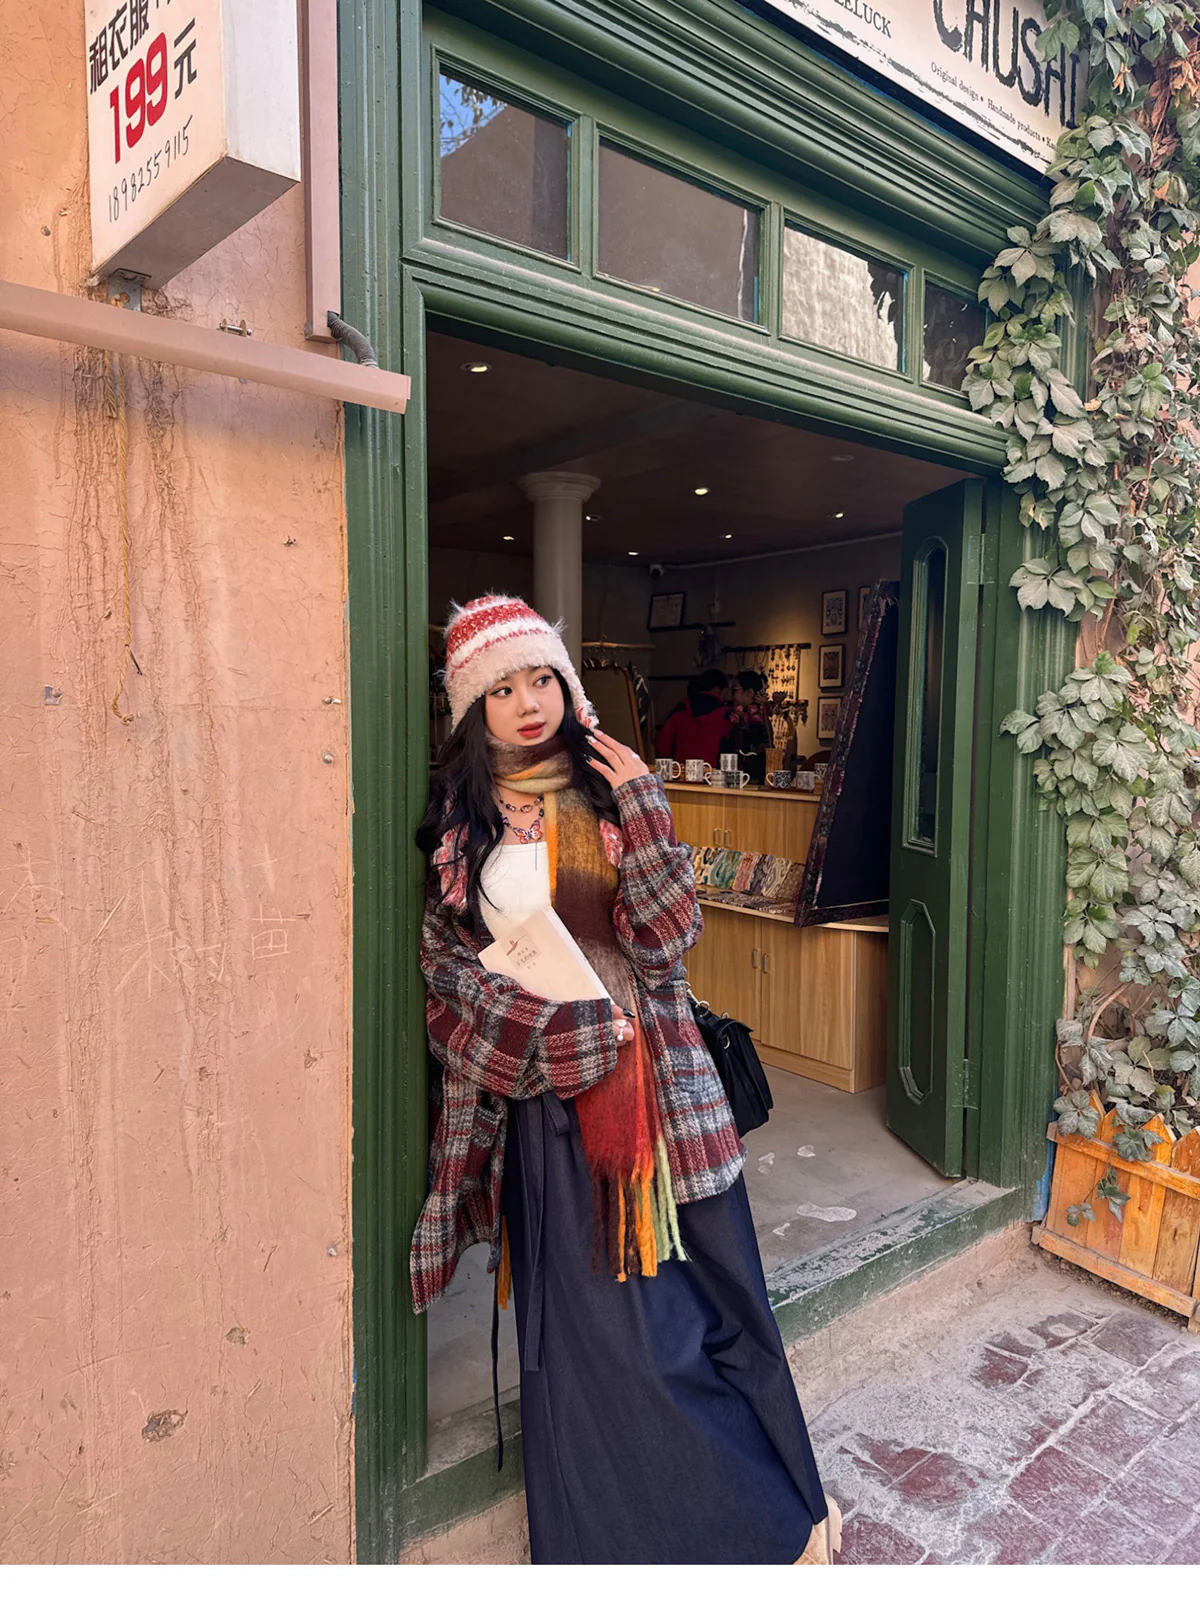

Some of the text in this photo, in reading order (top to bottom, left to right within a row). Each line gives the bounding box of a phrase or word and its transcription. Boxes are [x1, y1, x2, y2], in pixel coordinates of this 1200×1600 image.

[833, 0, 891, 39] ELUCK
[110, 17, 197, 165] 199 元
[930, 61, 957, 87] Original
[958, 79, 979, 102] design
[109, 114, 193, 223] 18982559115
